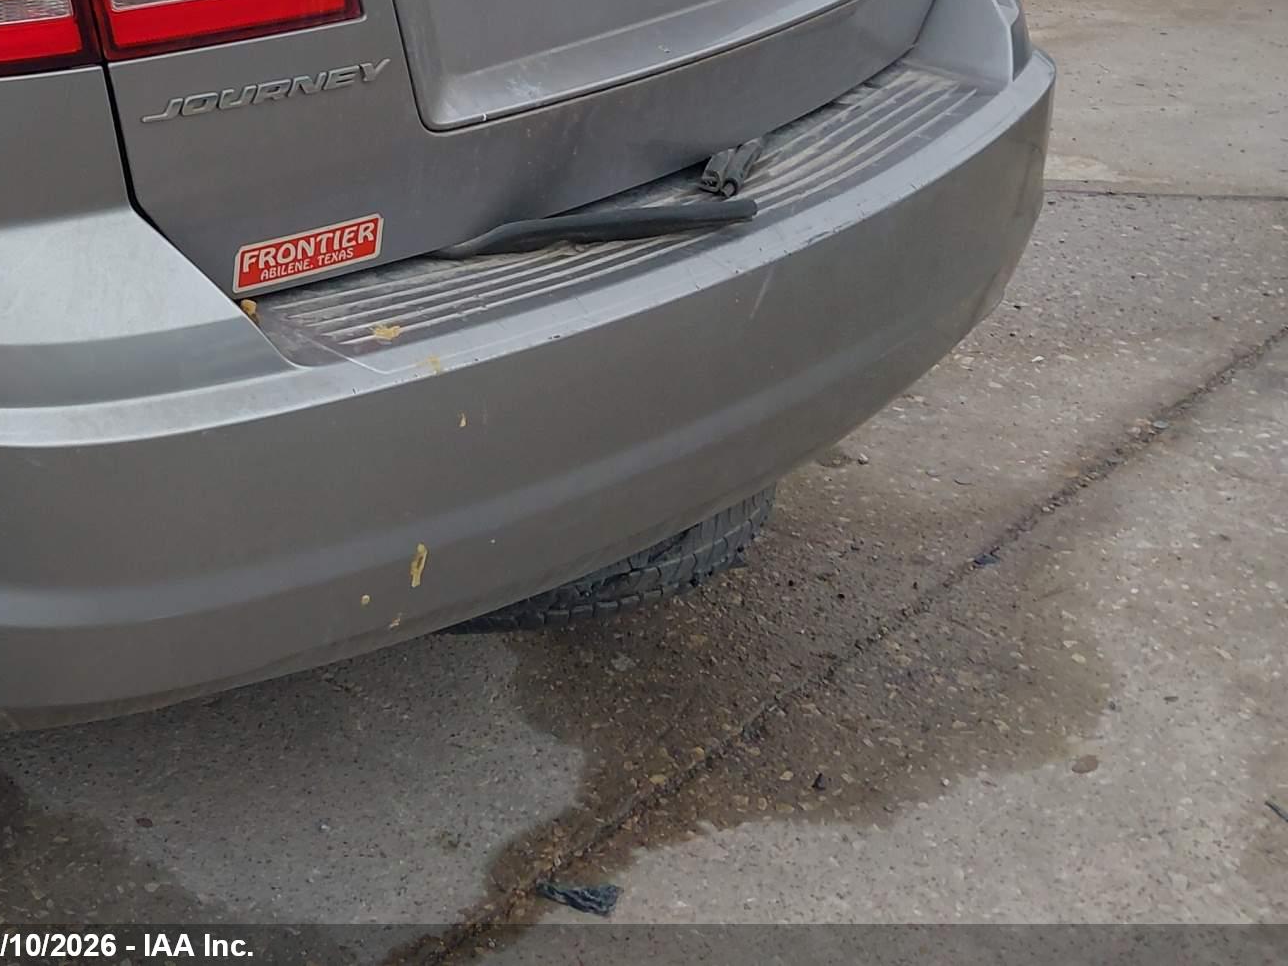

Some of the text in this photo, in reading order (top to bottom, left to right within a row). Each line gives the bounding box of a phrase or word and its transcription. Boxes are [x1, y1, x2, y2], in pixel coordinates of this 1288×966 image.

[140, 58, 391, 123] JOURNEY
[242, 222, 374, 273] FRONTIER
[318, 247, 354, 266] TEXAS
